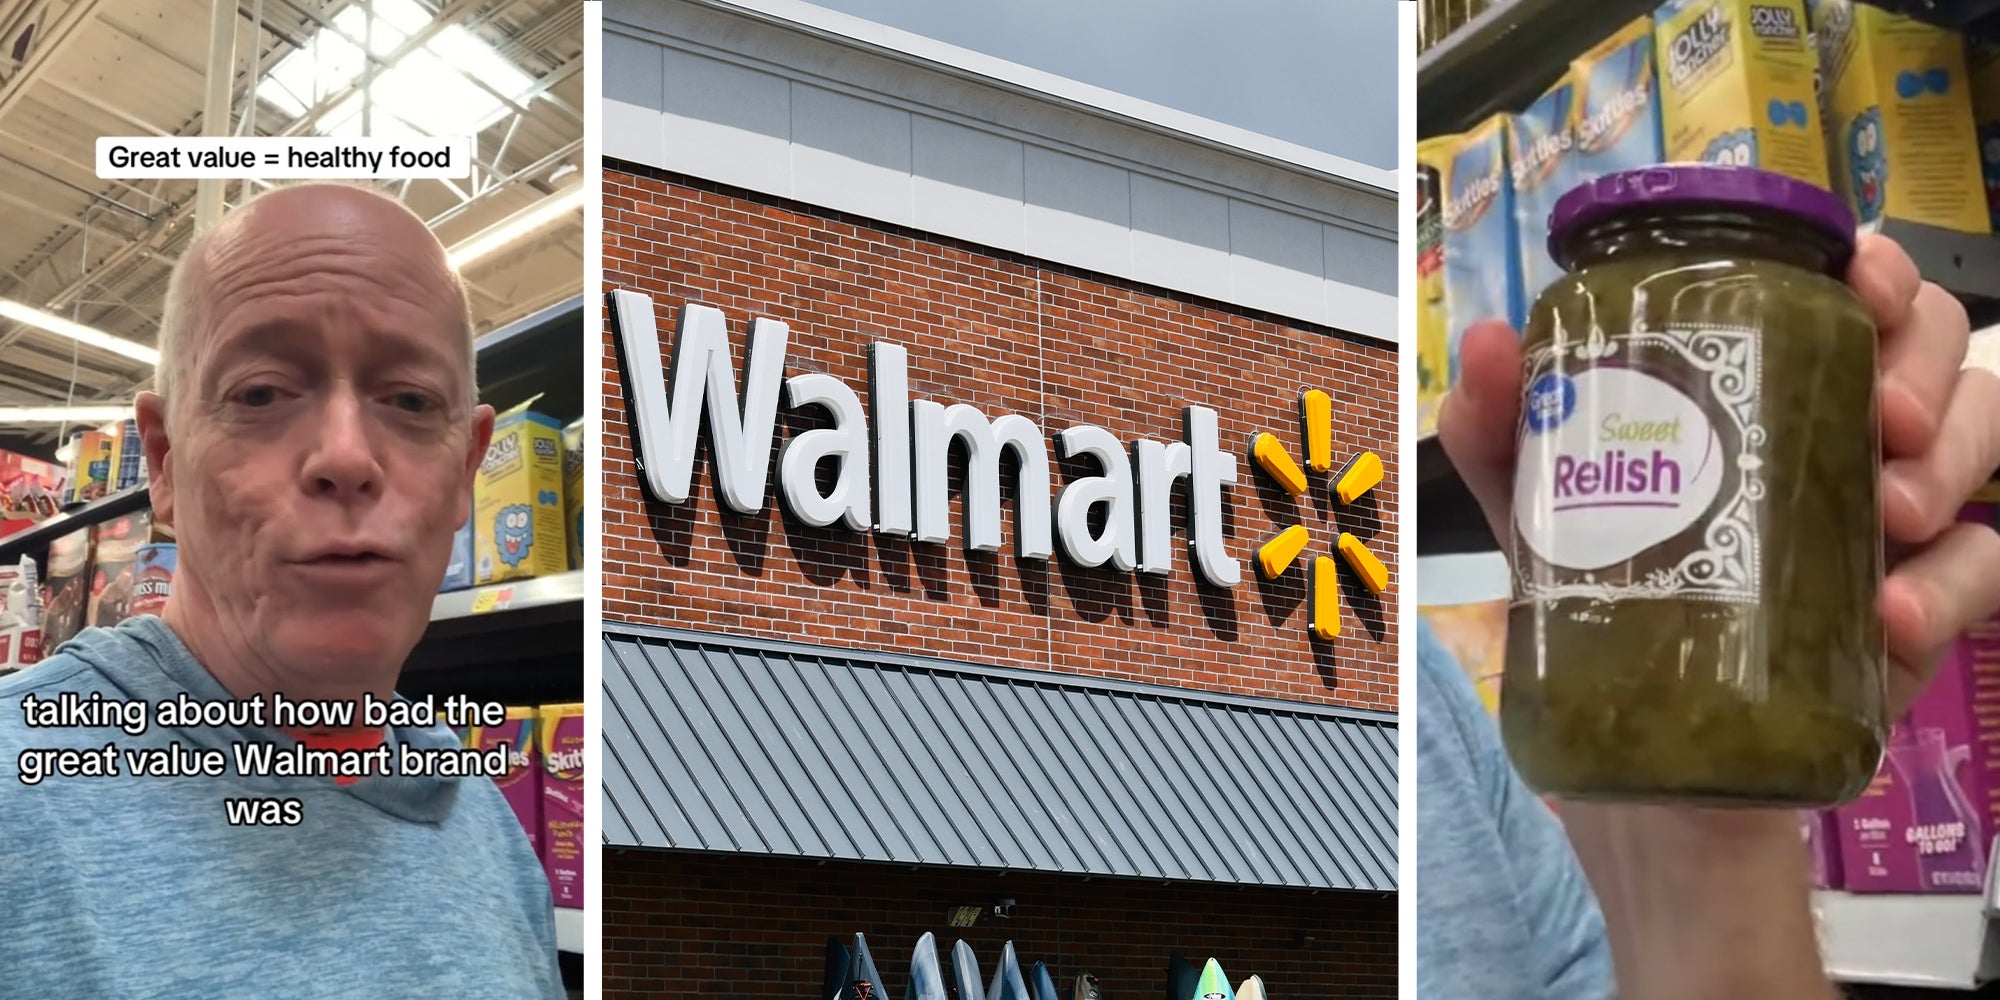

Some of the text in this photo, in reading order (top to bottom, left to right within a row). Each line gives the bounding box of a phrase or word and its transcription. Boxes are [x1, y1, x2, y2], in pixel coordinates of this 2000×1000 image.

[1752, 8, 1792, 28] JOLLY
[607, 289, 1242, 589] Walmart
[1600, 413, 1682, 443] Sweet
[486, 433, 518, 461] OLLY
[1554, 450, 1681, 498] Relish
[547, 747, 584, 774] Skitt
